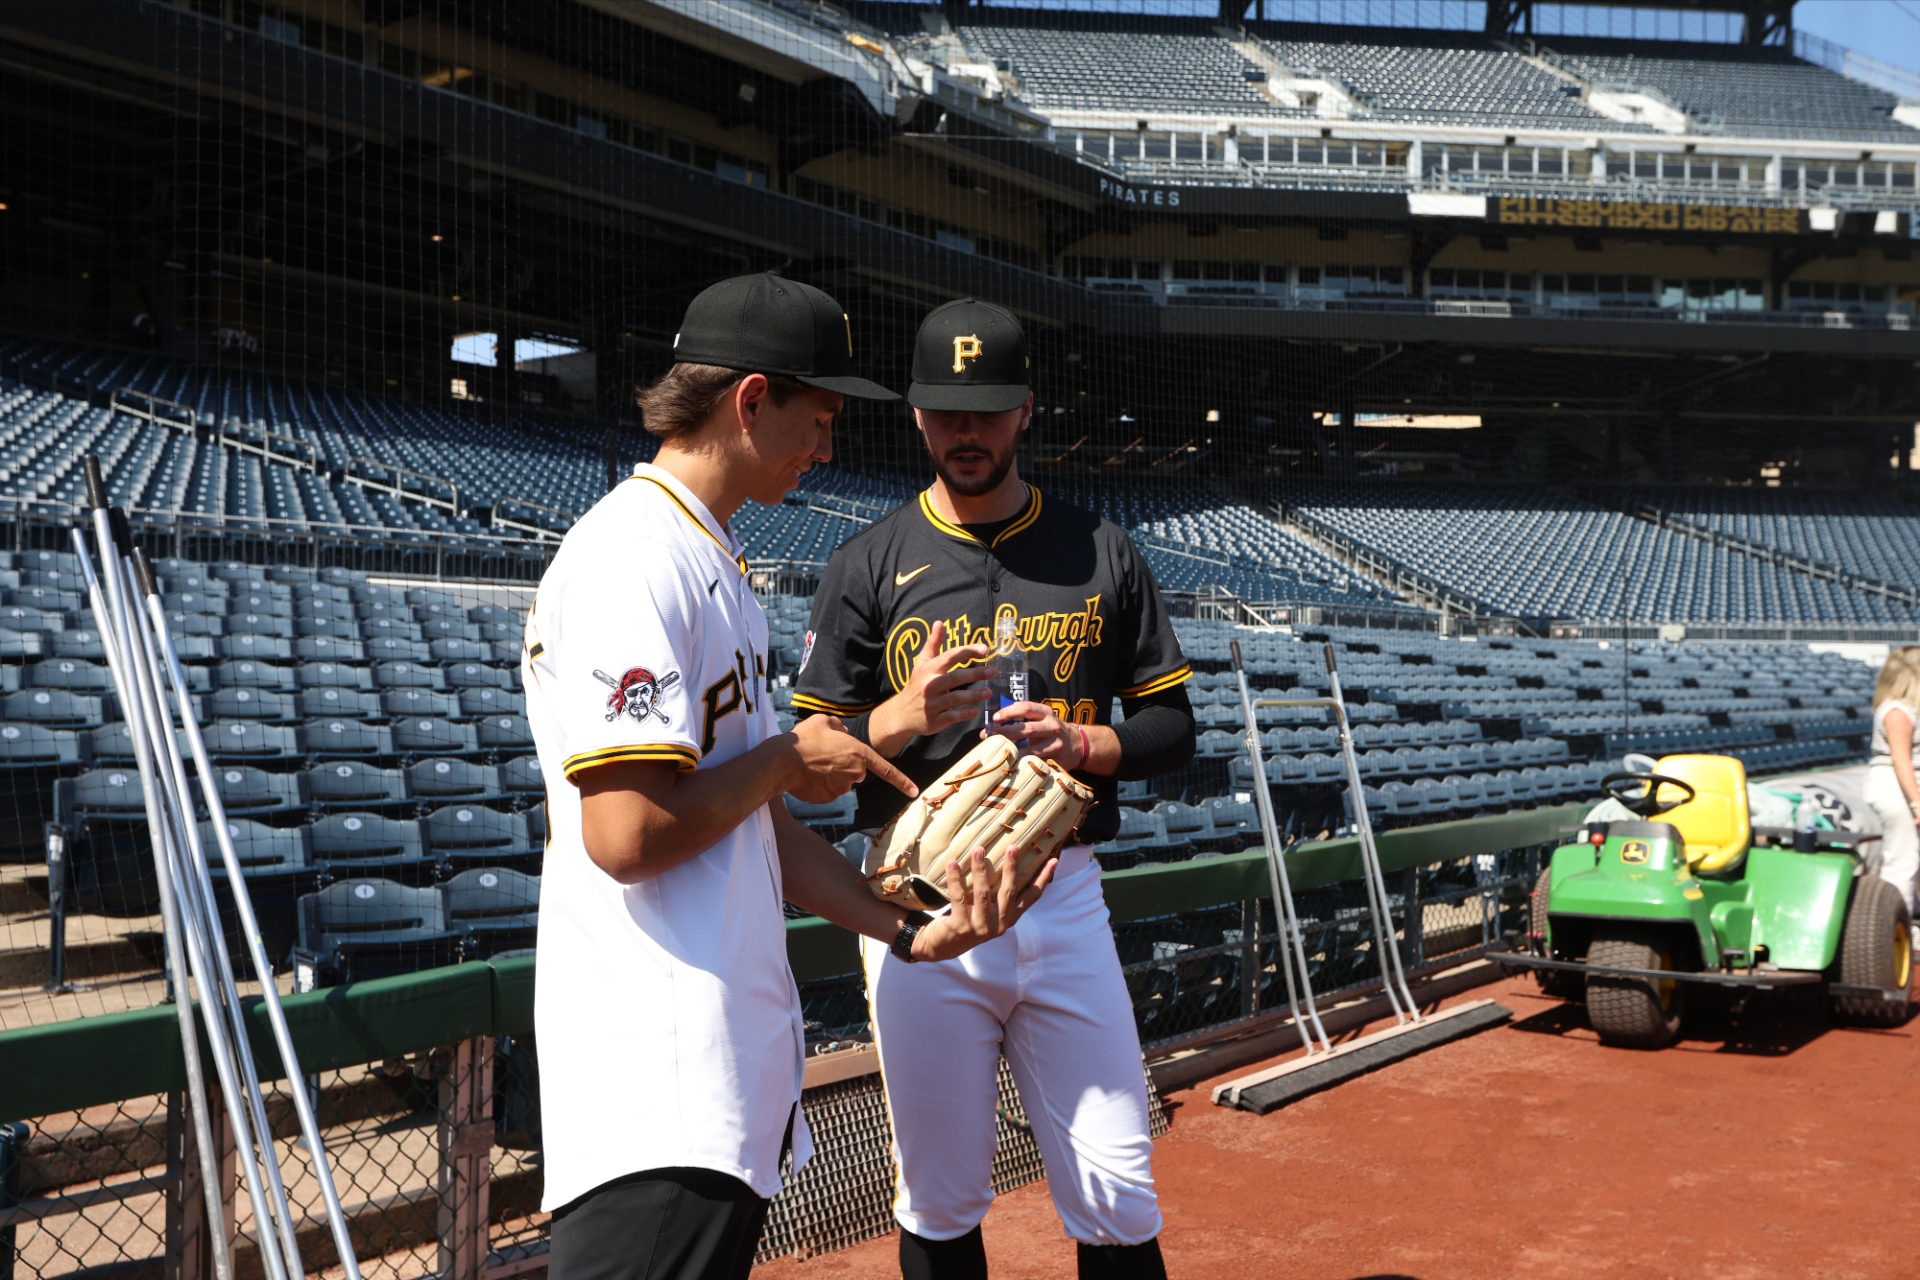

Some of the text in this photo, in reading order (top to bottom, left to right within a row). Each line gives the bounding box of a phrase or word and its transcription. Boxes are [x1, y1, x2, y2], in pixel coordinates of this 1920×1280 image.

[1100, 178, 1180, 206] PIRATES
[952, 333, 983, 373] P
[886, 594, 1103, 693] Pttsburgh
[1009, 672, 1025, 701] art
